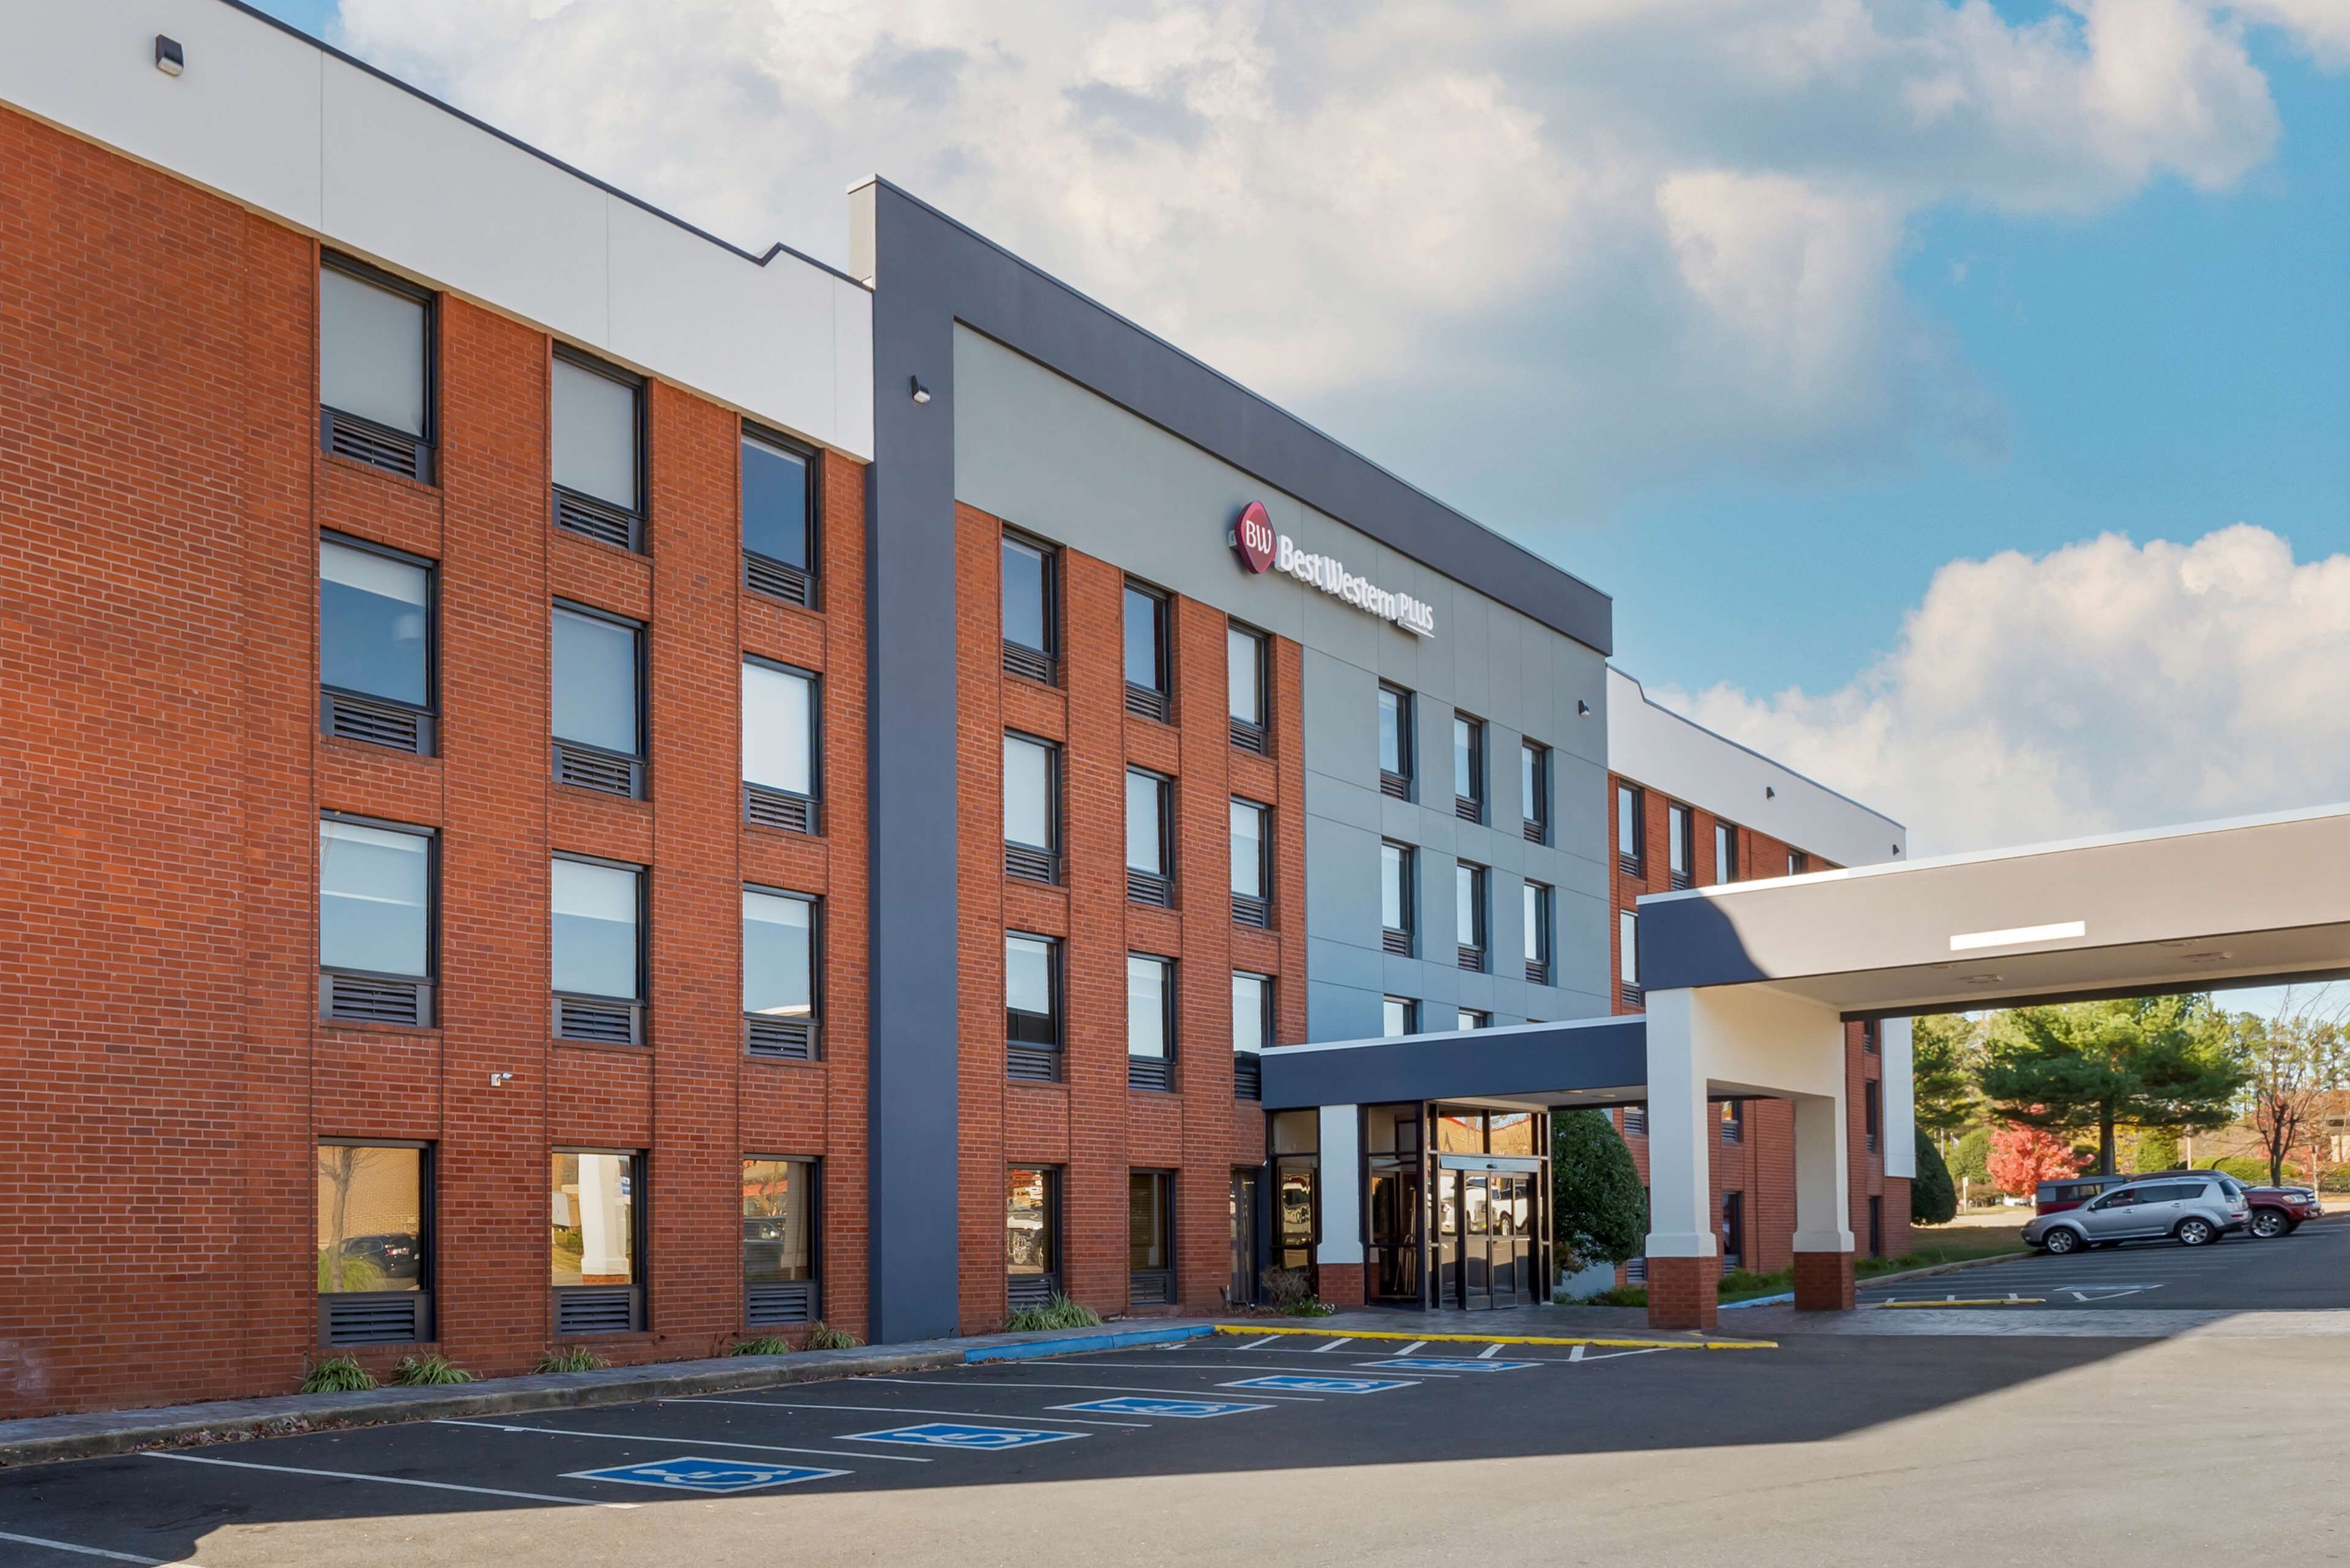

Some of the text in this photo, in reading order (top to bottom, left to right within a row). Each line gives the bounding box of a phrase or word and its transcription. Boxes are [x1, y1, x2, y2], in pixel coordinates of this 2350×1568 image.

[1246, 520, 1272, 554] BW
[1279, 534, 1434, 630] Best Western PLUS
